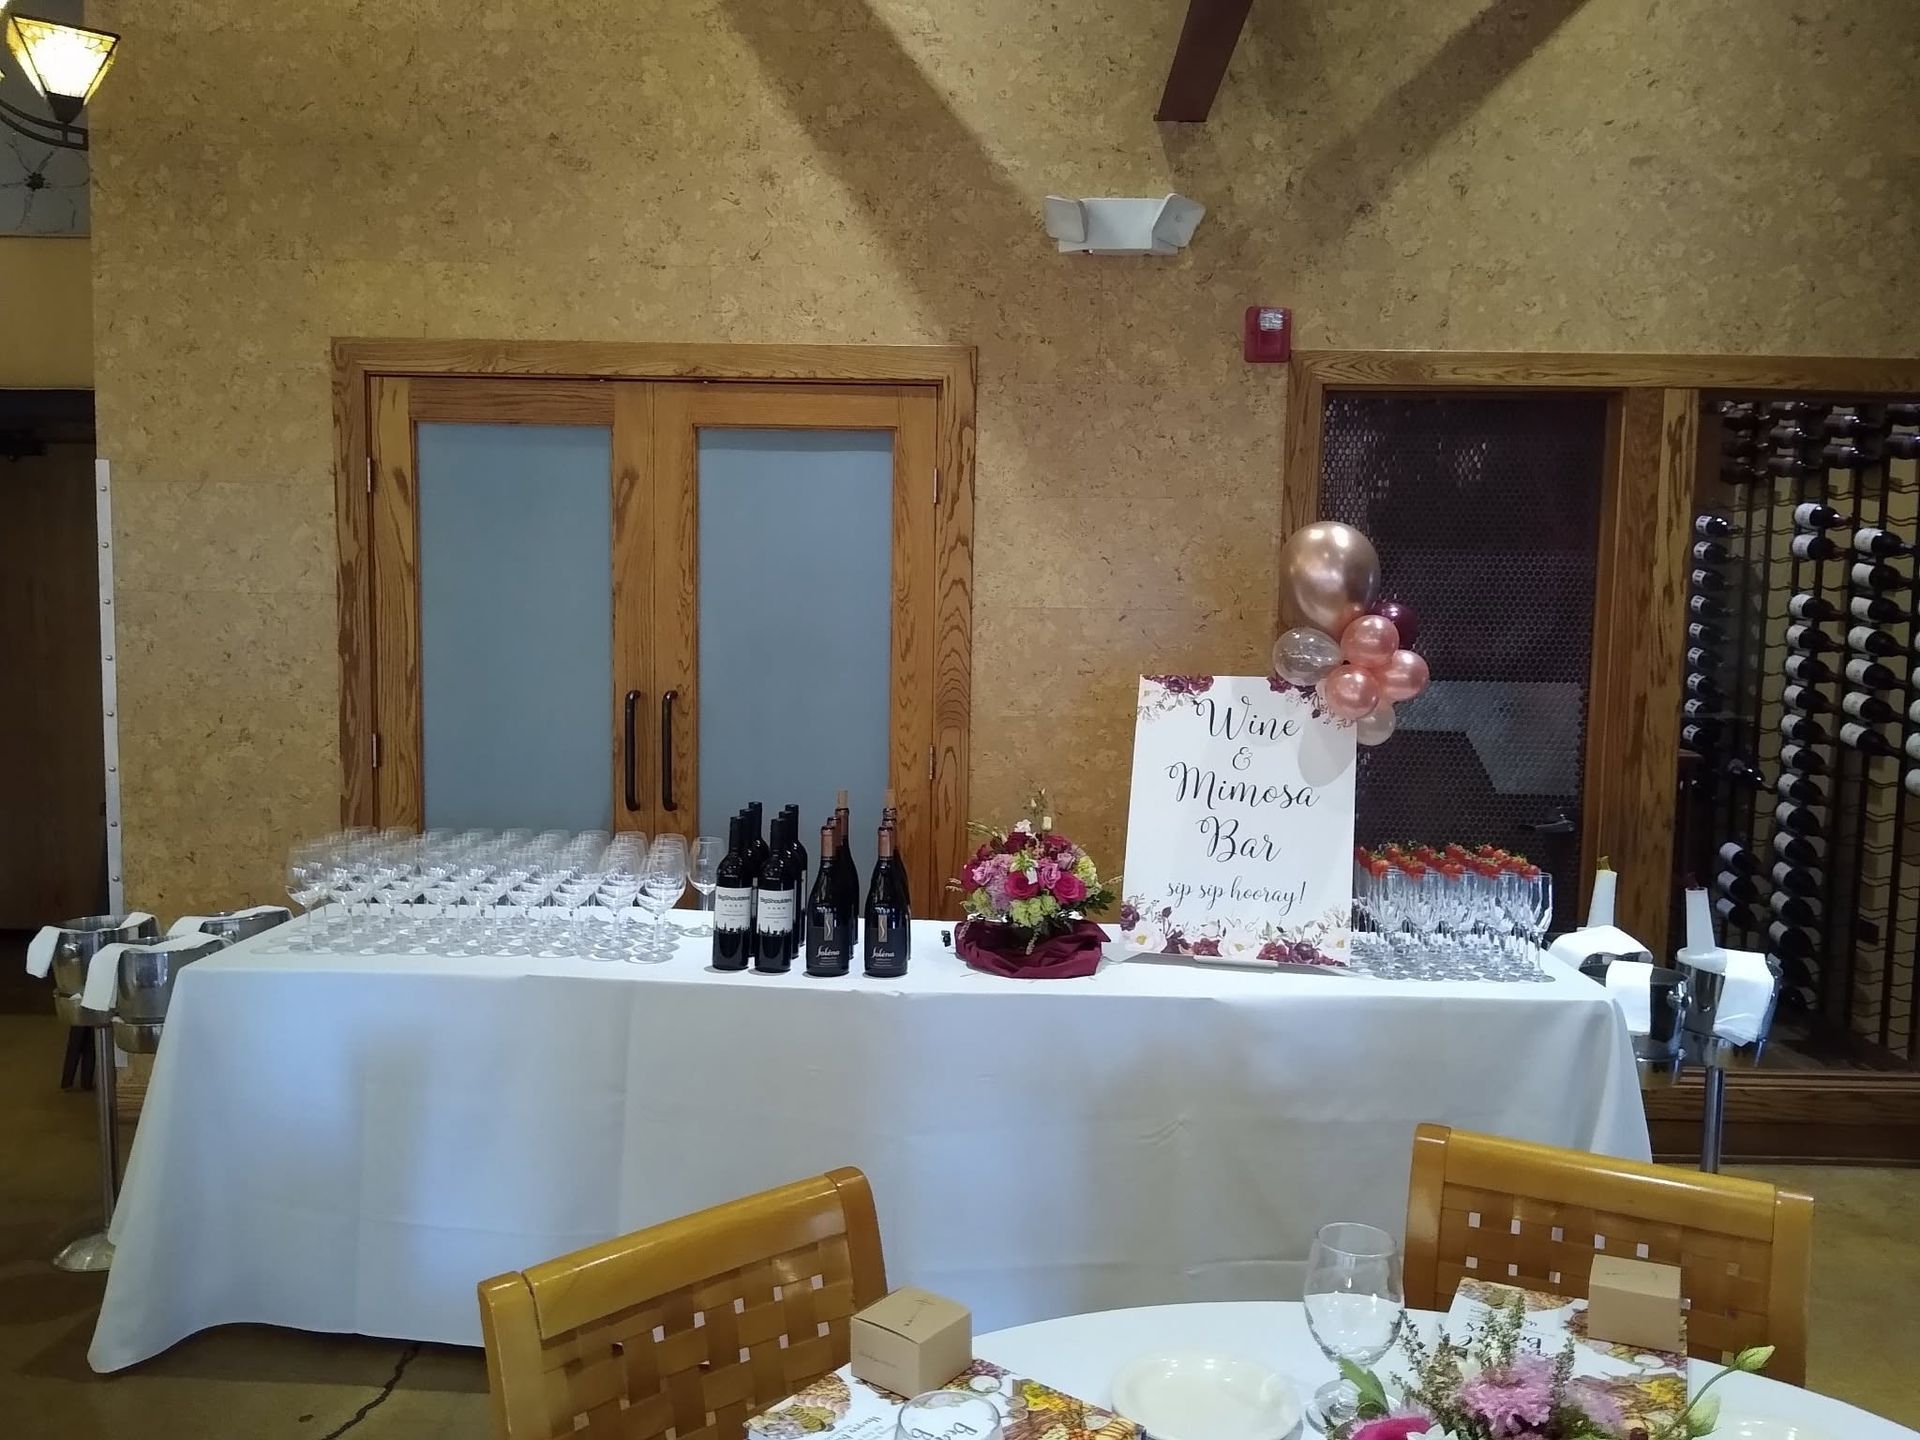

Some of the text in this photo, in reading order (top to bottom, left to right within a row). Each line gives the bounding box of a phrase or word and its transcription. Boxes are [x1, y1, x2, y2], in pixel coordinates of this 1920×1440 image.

[1194, 695, 1301, 741] Wine
[1232, 746, 1252, 770] &
[1165, 761, 1321, 810] Mimosa
[1196, 815, 1282, 863] Bar
[1166, 875, 1307, 916] sip sip hooray!
